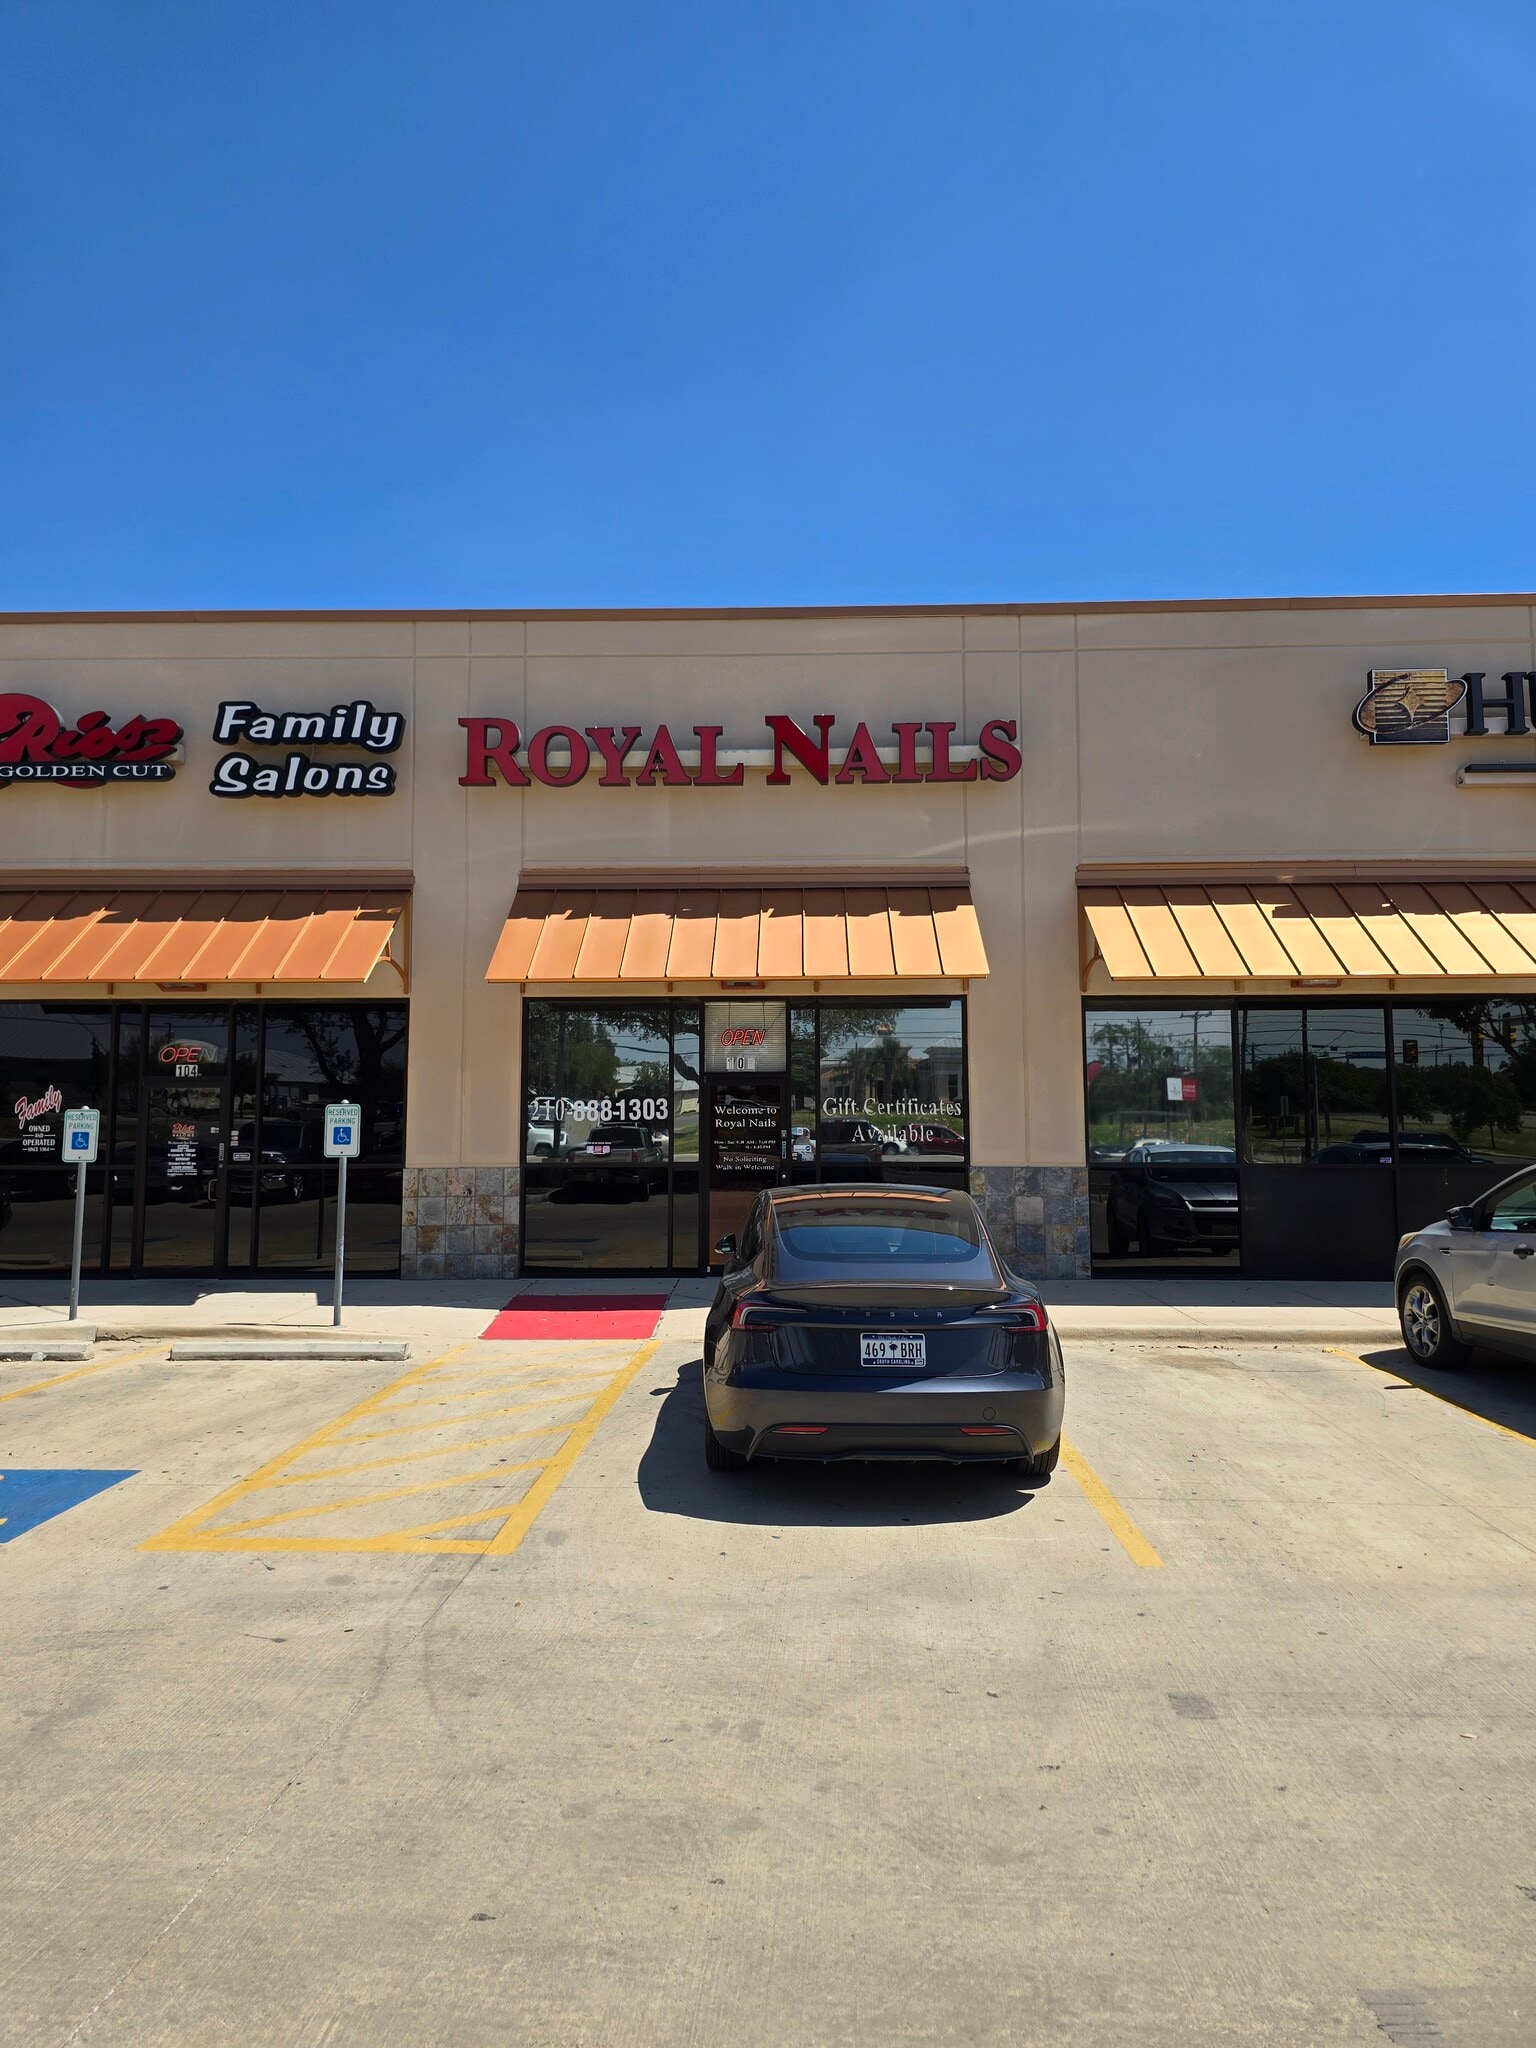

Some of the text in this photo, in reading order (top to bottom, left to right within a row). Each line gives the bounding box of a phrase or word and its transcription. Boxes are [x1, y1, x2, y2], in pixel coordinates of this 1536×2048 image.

[1462, 672, 1536, 736] H
[216, 702, 402, 750] Family
[457, 714, 1024, 788] ROYAL NAILS
[0, 764, 168, 778] GOLDEN CUT
[211, 754, 394, 795] Salons
[721, 1028, 766, 1047] OPEN
[161, 1046, 217, 1063] OPEN
[177, 1065, 198, 1077] 104
[15, 1084, 63, 1130] Family
[328, 1108, 358, 1116] RESERVED
[530, 1097, 669, 1122] 210-888-1303
[714, 1105, 777, 1115] Welcome to
[822, 1097, 962, 1116] Gift Certificates
[67, 1113, 97, 1121] RESERVED
[329, 1117, 356, 1125] PARKING
[715, 1118, 777, 1129] Royal Nails
[69, 1122, 95, 1130] PARKING
[851, 1124, 934, 1142] Available
[865, 1342, 922, 1358] 469 BRH
